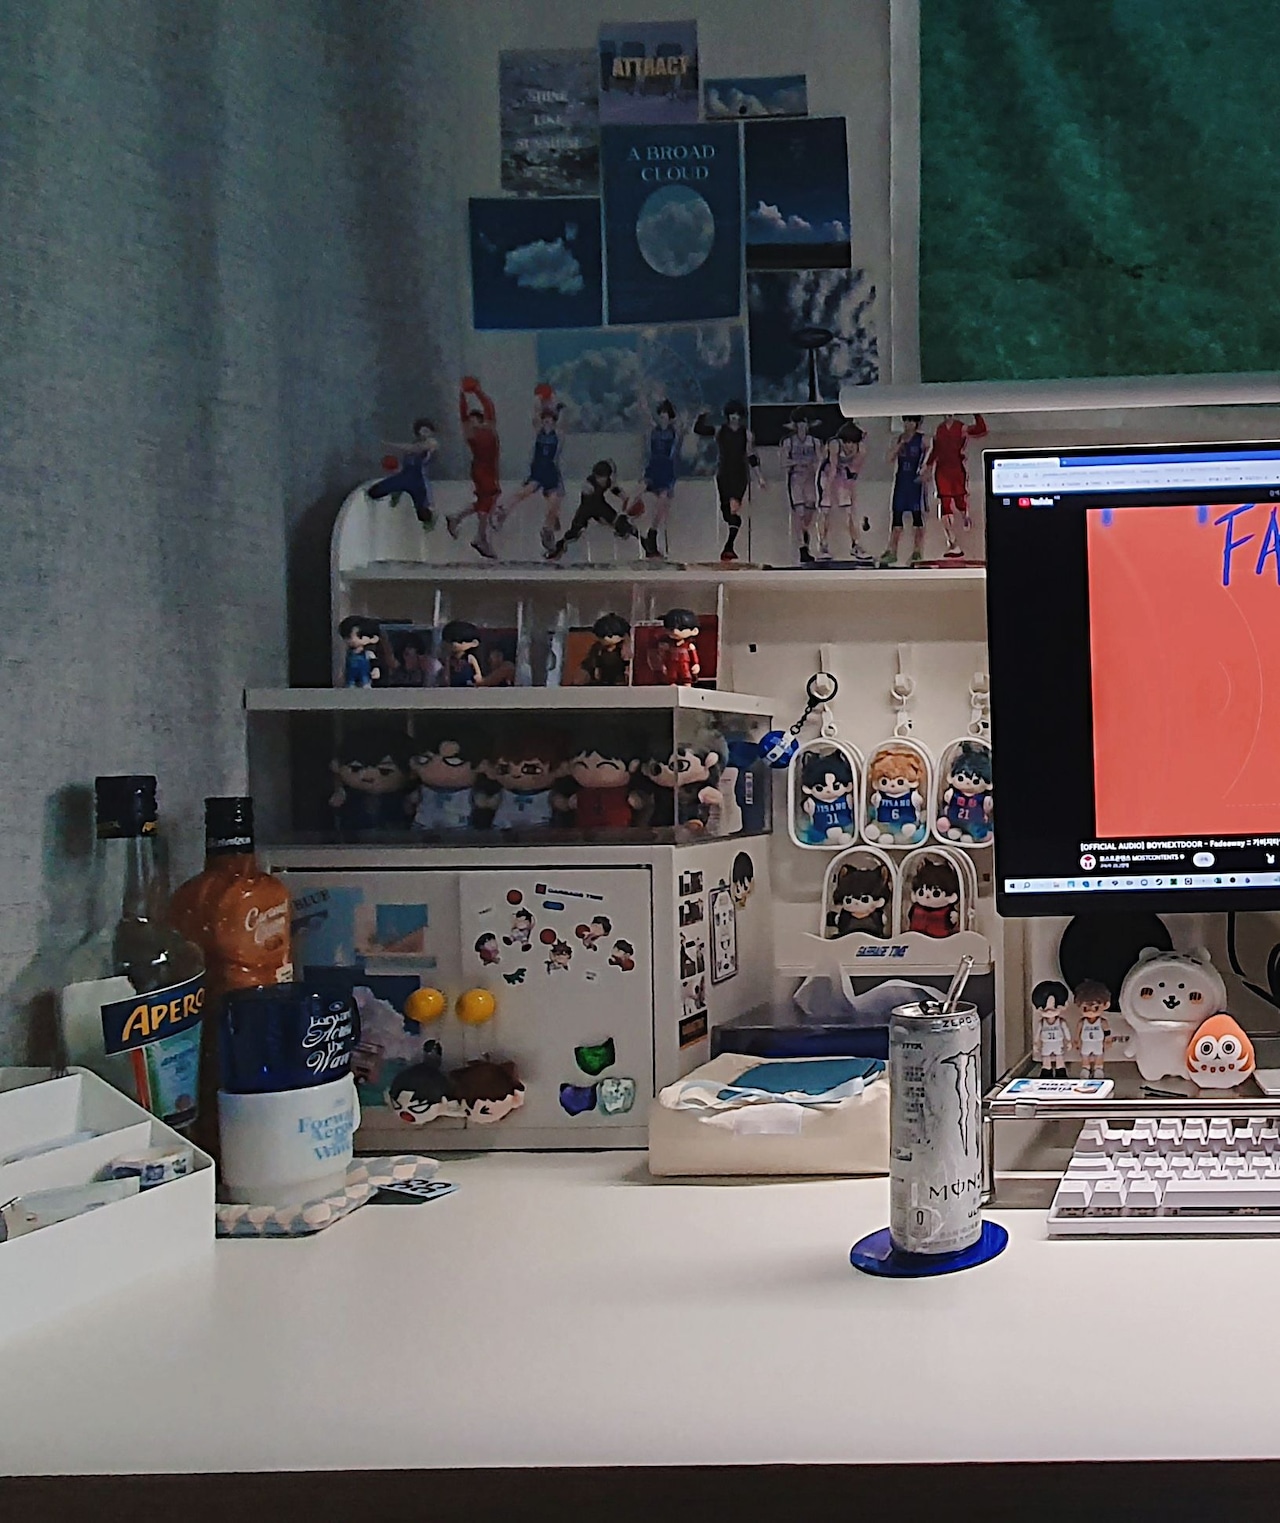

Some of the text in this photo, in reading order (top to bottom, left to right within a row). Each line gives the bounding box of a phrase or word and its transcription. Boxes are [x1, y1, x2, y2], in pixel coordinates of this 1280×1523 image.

[612, 56, 688, 77] ATTRACT
[628, 144, 715, 161] A BROAD
[641, 166, 709, 181] CLOUD
[1146, 840, 1203, 849] BOYNEXTDOOR
